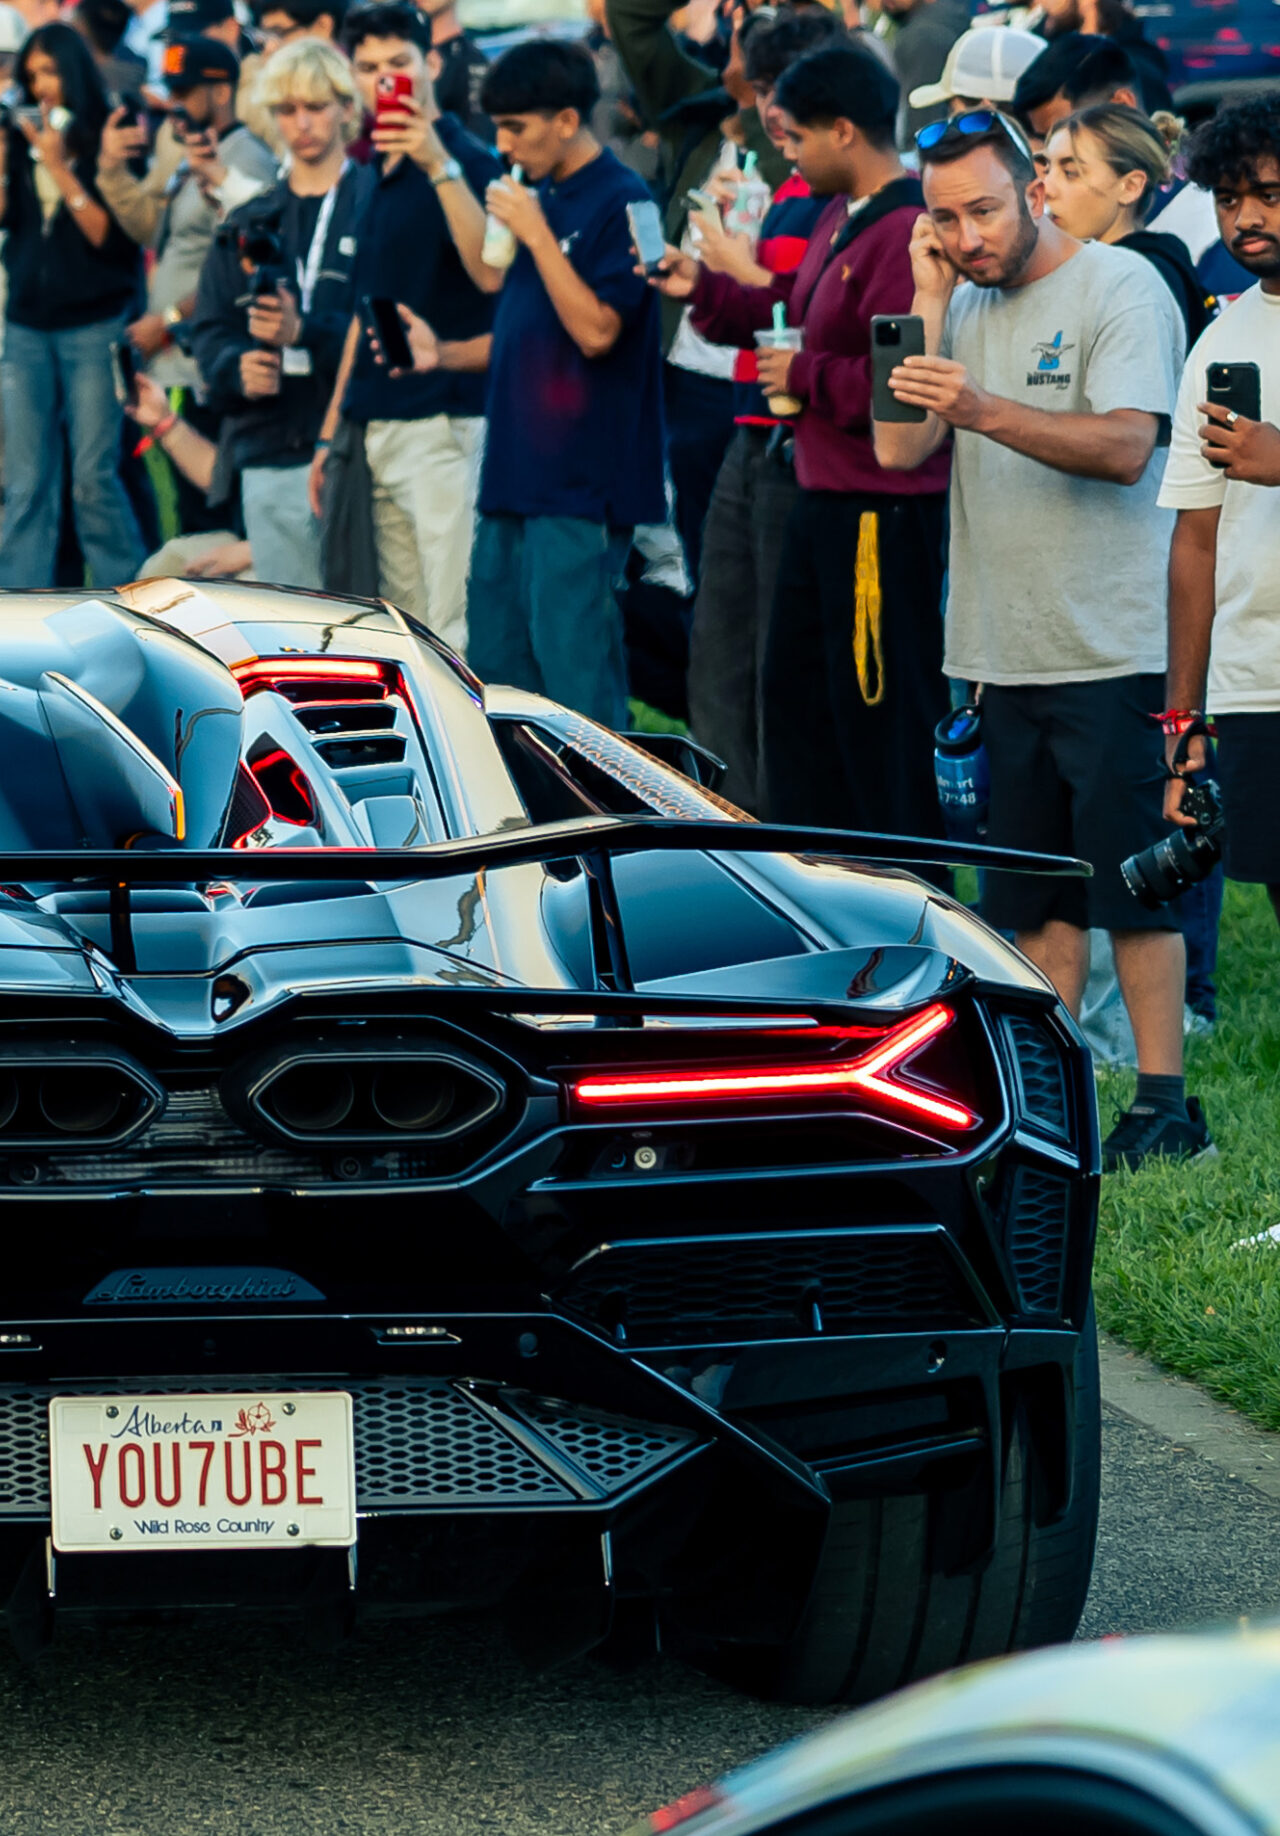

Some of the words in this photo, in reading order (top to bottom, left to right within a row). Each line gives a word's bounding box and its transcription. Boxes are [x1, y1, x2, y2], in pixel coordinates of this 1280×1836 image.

[96, 1271, 298, 1302] Lamborghini
[110, 1404, 213, 1438] Alberta
[82, 1439, 324, 1510] YOU7UBE
[133, 1519, 169, 1535] Wild
[174, 1518, 212, 1534] Rose
[218, 1517, 276, 1535] Country
